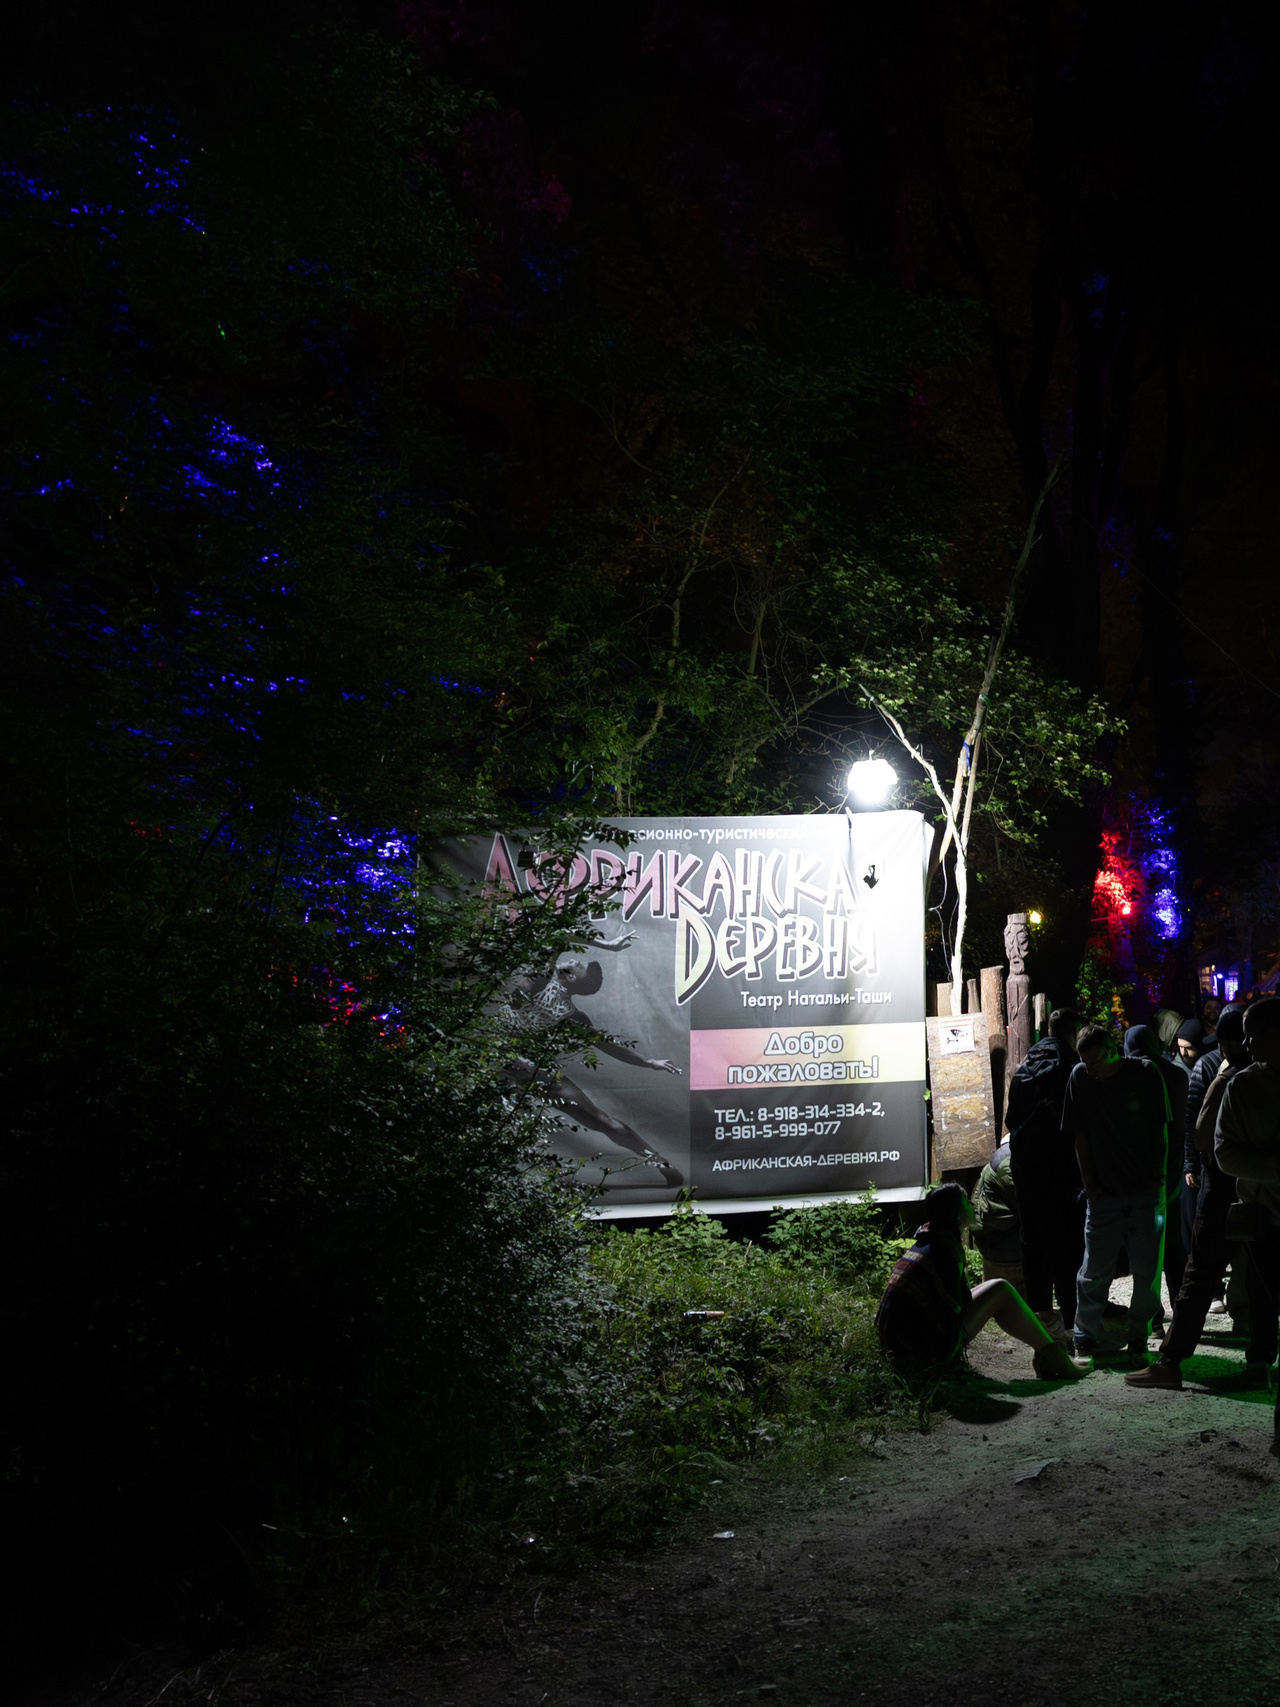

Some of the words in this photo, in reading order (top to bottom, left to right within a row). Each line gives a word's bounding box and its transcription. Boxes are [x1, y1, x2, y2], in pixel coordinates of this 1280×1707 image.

[740, 991, 784, 1011] Театр
[788, 988, 892, 1007] Натальи-Таши
[764, 1032, 843, 1058] Добро
[727, 1056, 879, 1084] пожаловать!
[714, 1108, 754, 1123] ТЕЛ.:
[757, 1102, 885, 1120] 8-918-314-334-2,
[714, 1121, 841, 1140] 8-961-5-999-077
[711, 1150, 900, 1172] АФРИКАНСКАЯ-ДЕРЕВНЯ.РФ
